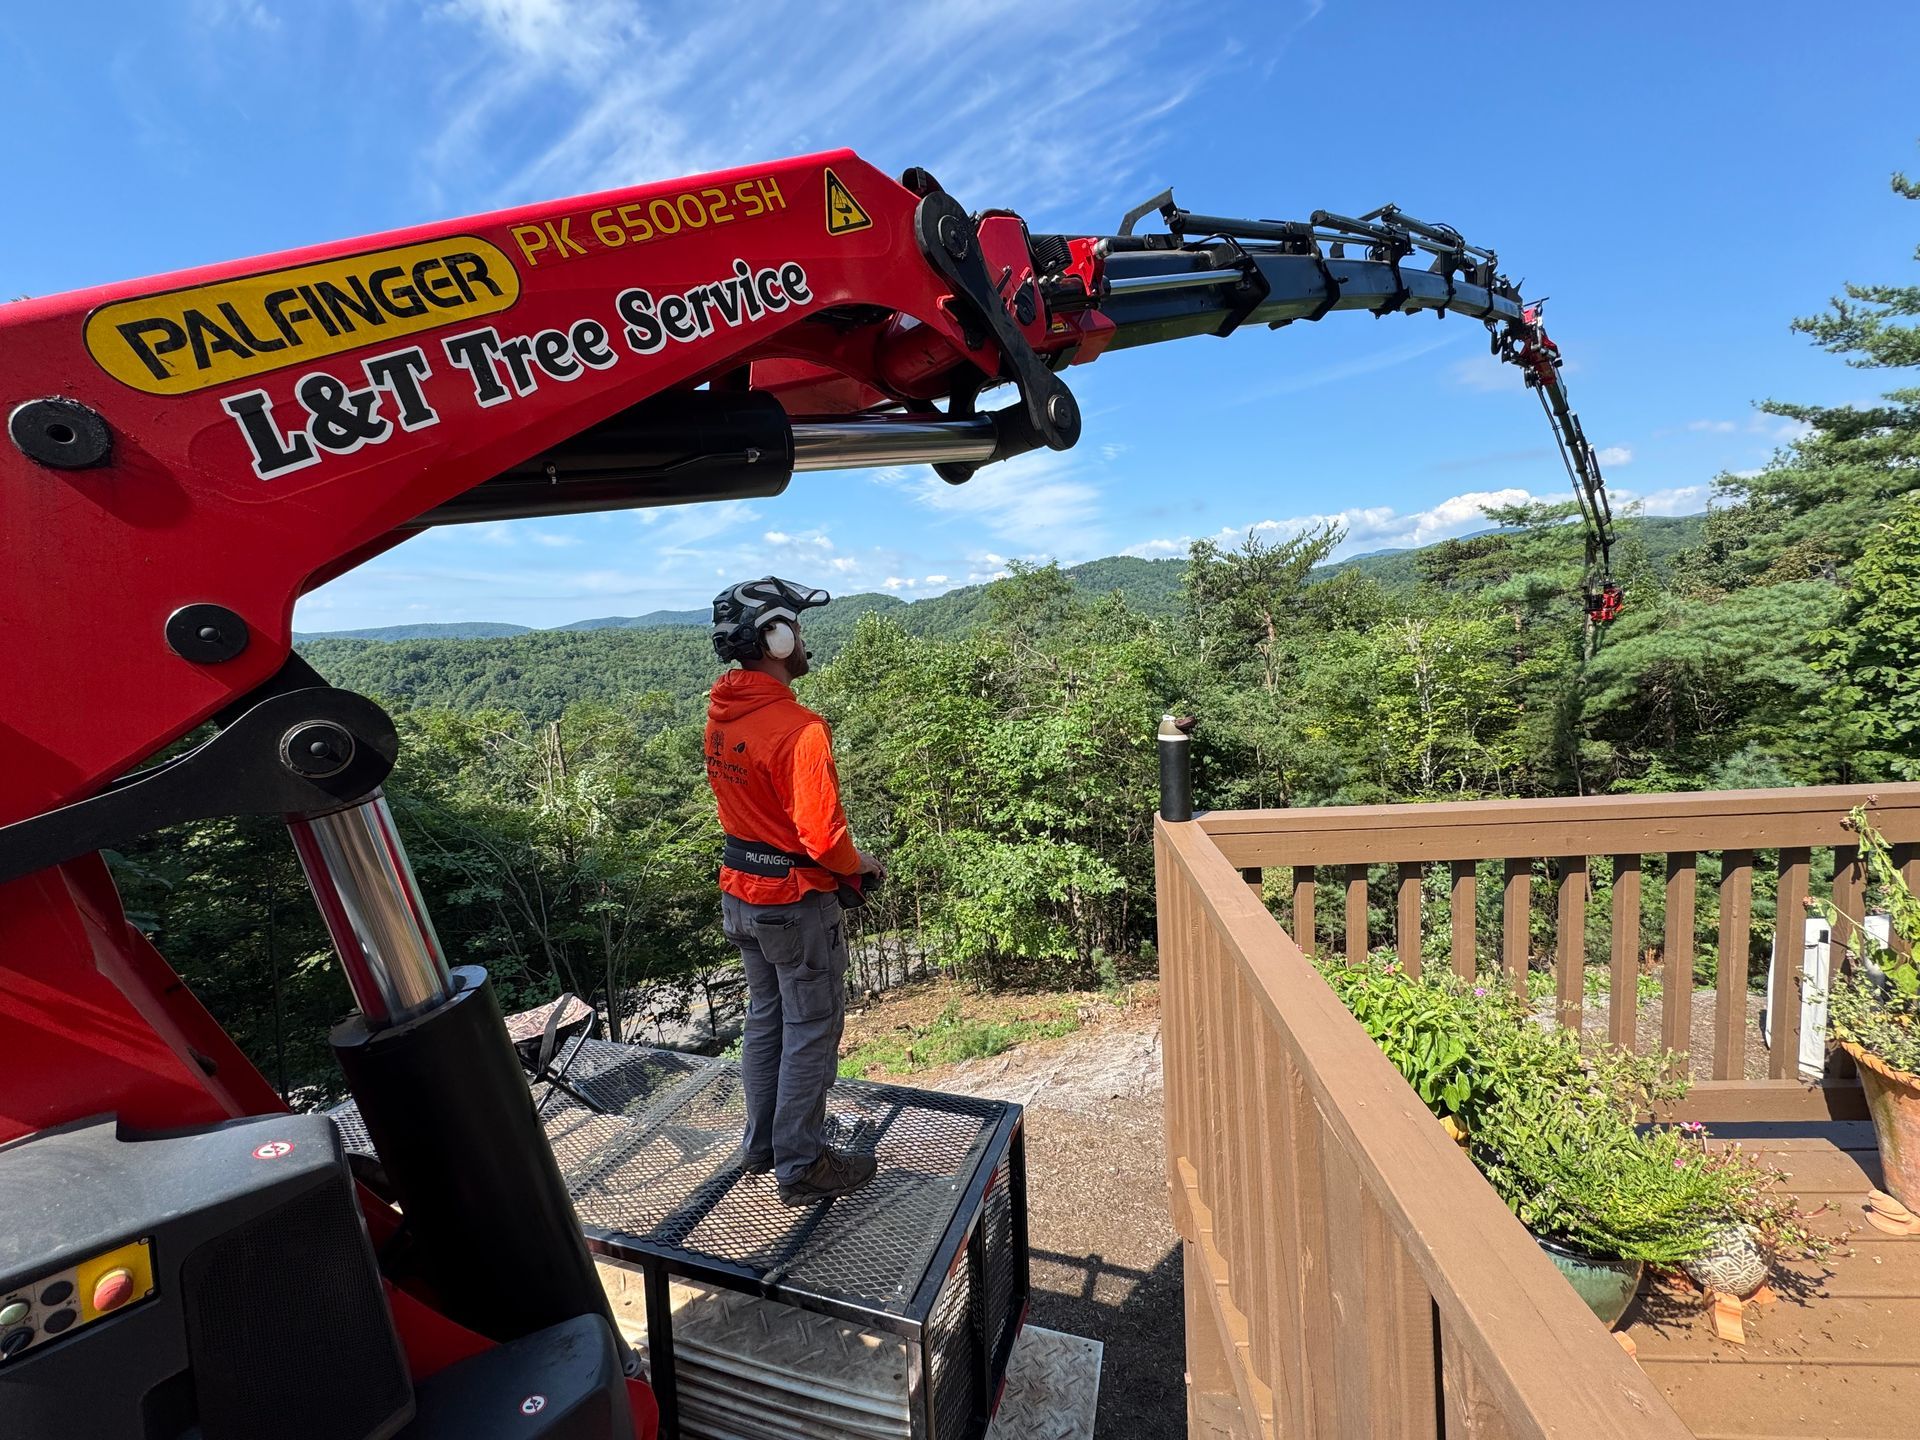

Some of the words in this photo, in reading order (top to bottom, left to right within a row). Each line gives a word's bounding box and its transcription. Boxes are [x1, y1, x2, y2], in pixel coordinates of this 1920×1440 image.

[511, 217, 588, 266] PK
[115, 252, 504, 381] PALFINGER
[221, 347, 439, 480] L&T
[442, 319, 617, 408] Tree
[616, 259, 813, 354] Service
